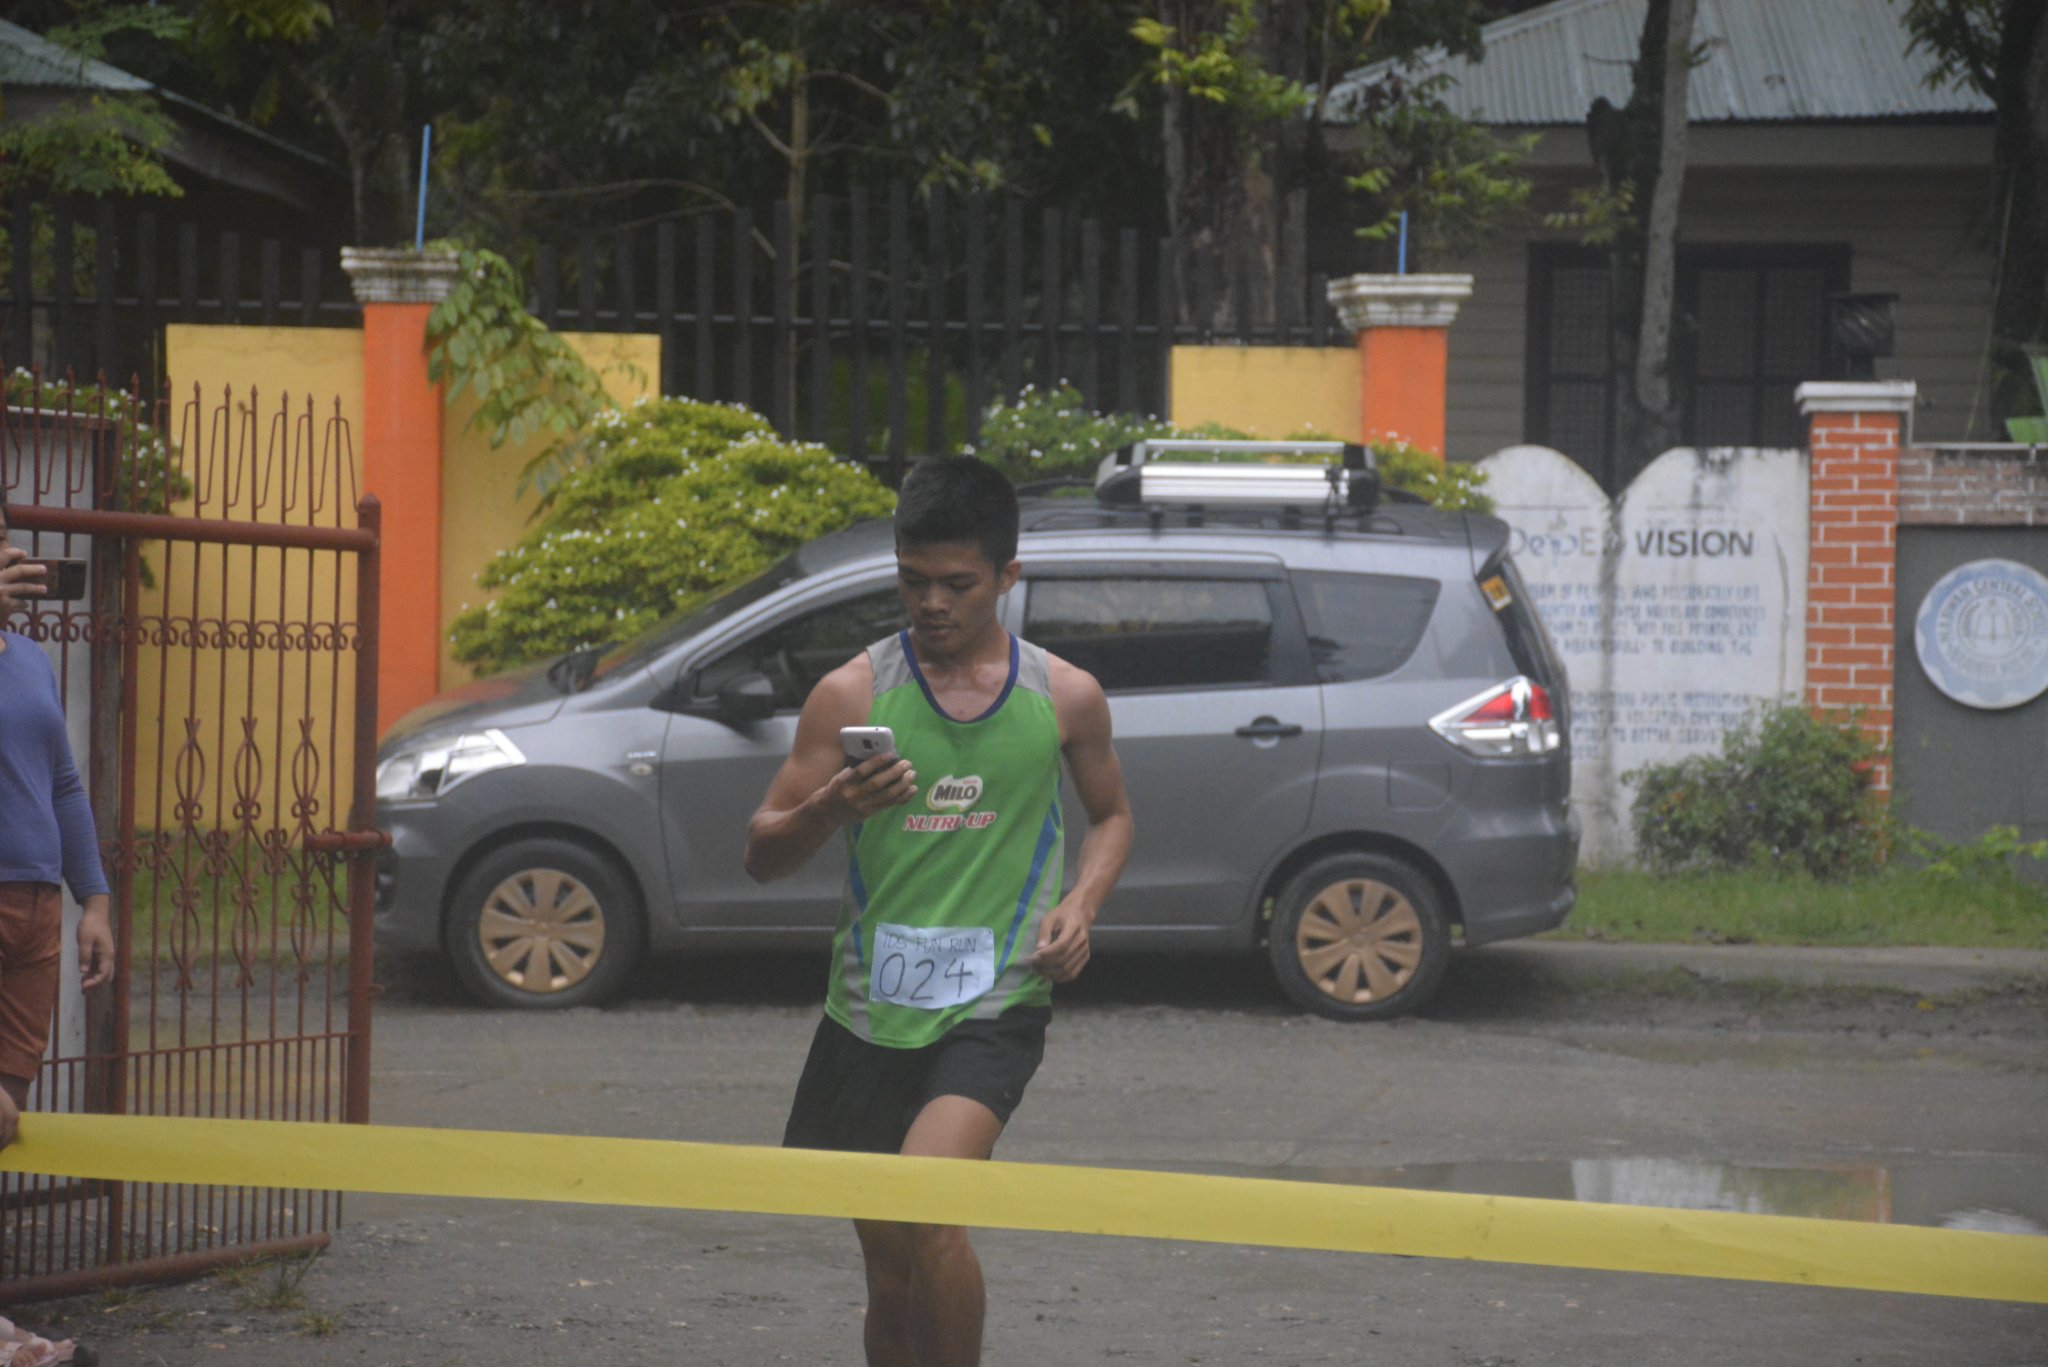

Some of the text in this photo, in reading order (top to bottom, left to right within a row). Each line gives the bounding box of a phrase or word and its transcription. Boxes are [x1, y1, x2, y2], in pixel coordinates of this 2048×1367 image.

[1635, 529, 1754, 557] VISION
[933, 784, 978, 801] MILO
[915, 936, 942, 953] FUN
[949, 937, 977, 953] RUN
[879, 951, 973, 1001] 024
